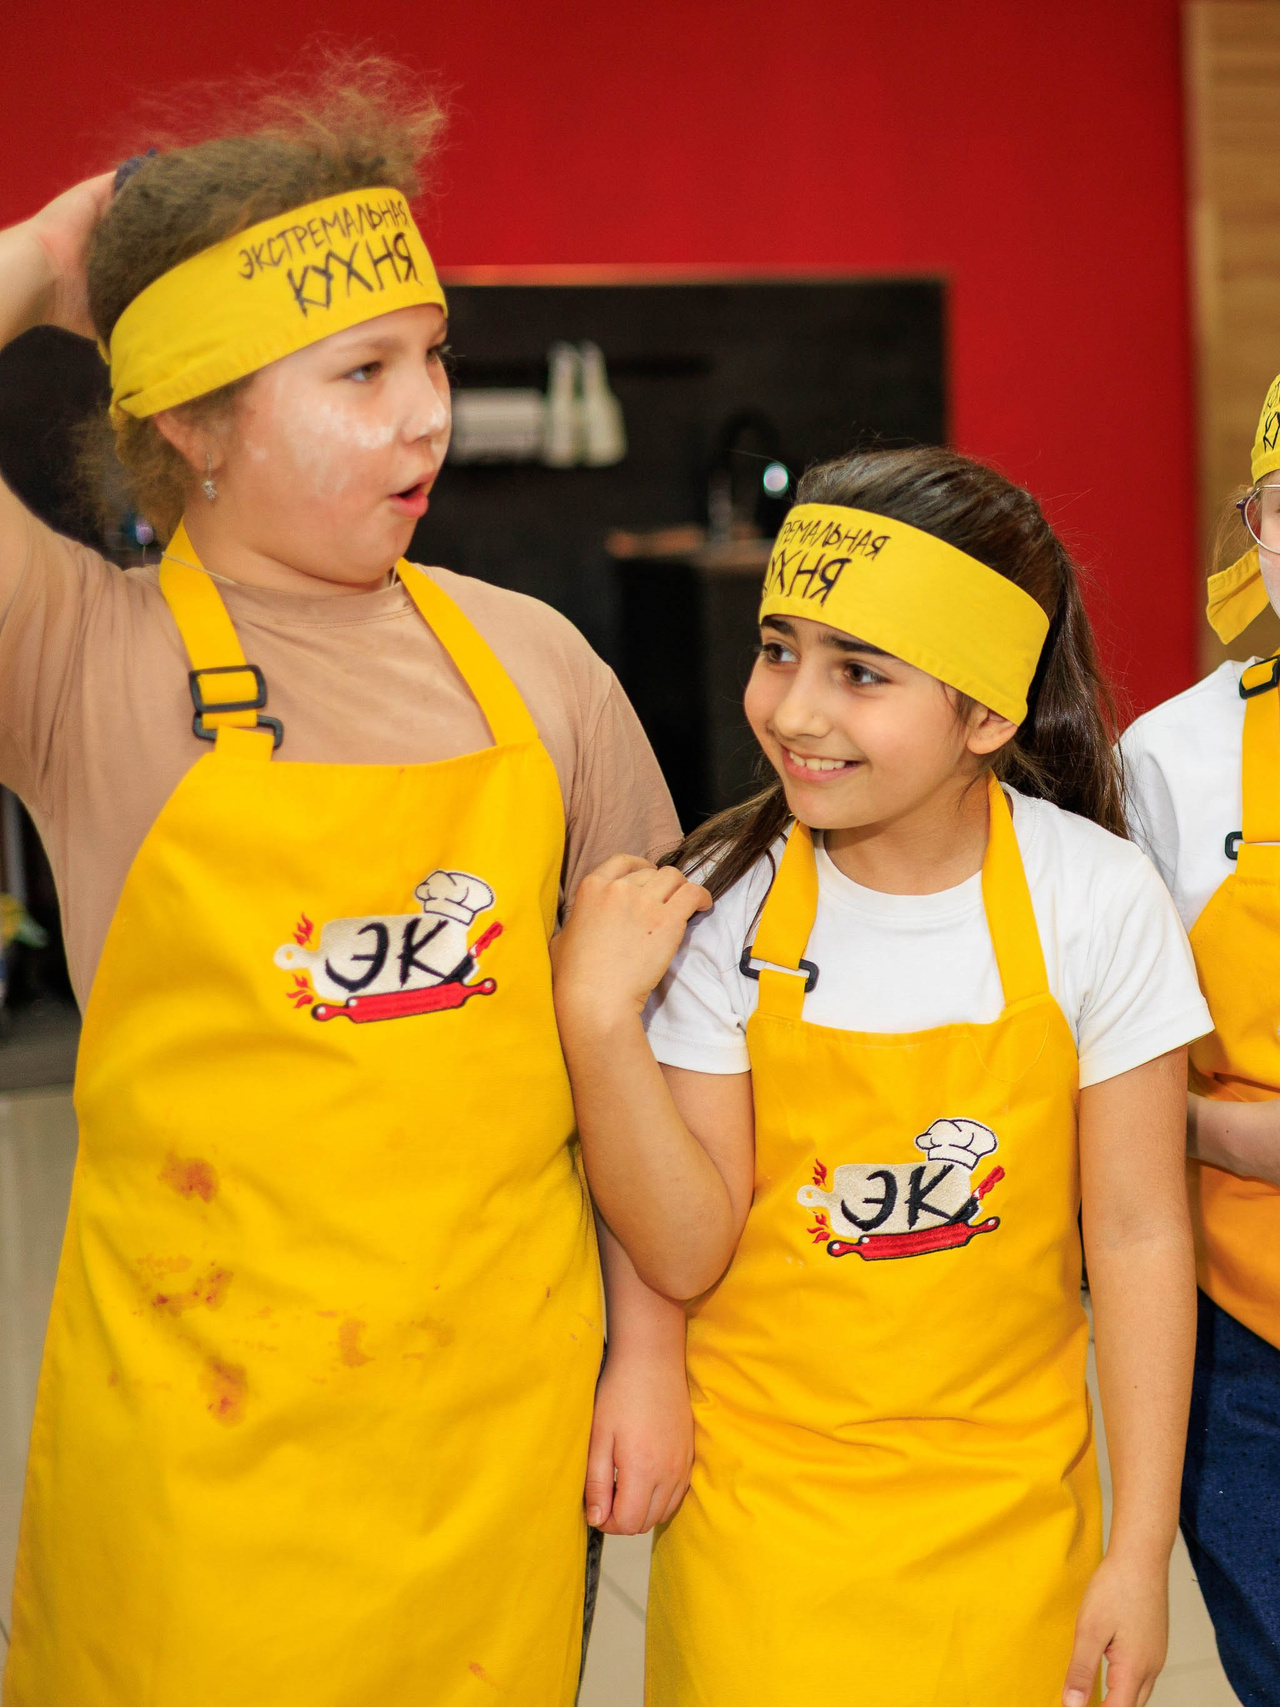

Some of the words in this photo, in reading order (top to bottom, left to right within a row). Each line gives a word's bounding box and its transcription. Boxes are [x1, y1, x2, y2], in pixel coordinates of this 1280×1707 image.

[239, 199, 411, 281] ЭКСТРЕМАЛЬНАЯ
[286, 231, 423, 317] КУХНЯ
[778, 519, 891, 561] РЕМАЛЬНАЯ
[764, 548, 852, 607] УХНЯ
[325, 917, 449, 993] ЭК
[841, 1163, 955, 1232] ЭК
